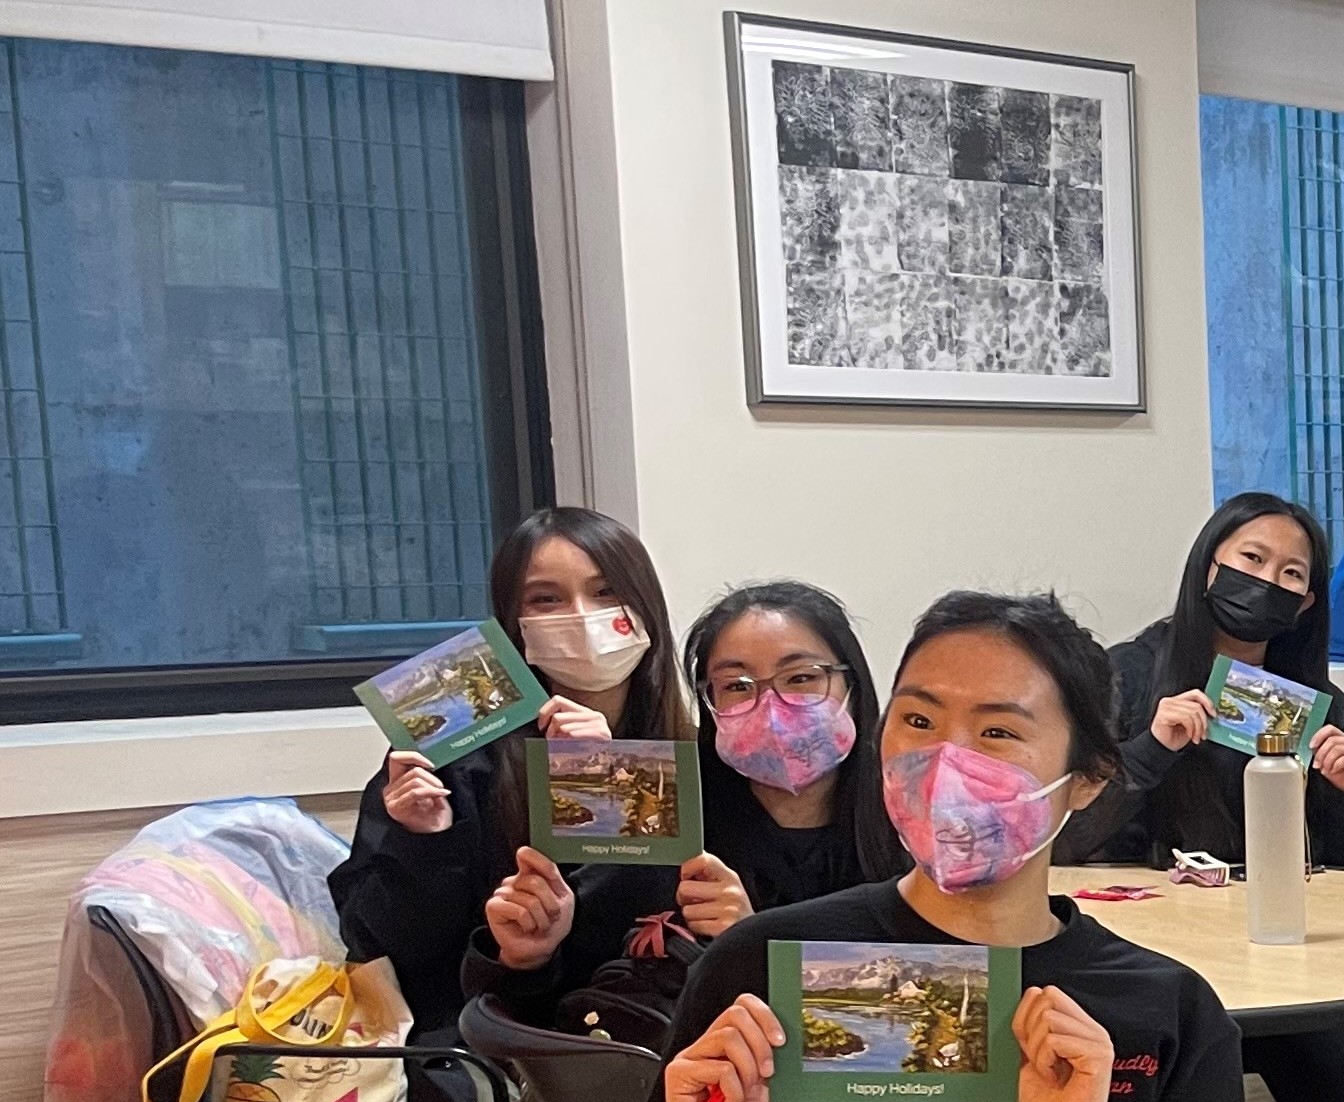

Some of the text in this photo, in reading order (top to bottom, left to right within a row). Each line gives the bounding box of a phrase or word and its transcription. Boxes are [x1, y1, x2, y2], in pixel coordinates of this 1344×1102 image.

[582, 844, 610, 855] Happy
[847, 1082, 945, 1097] Happy Holidays!
